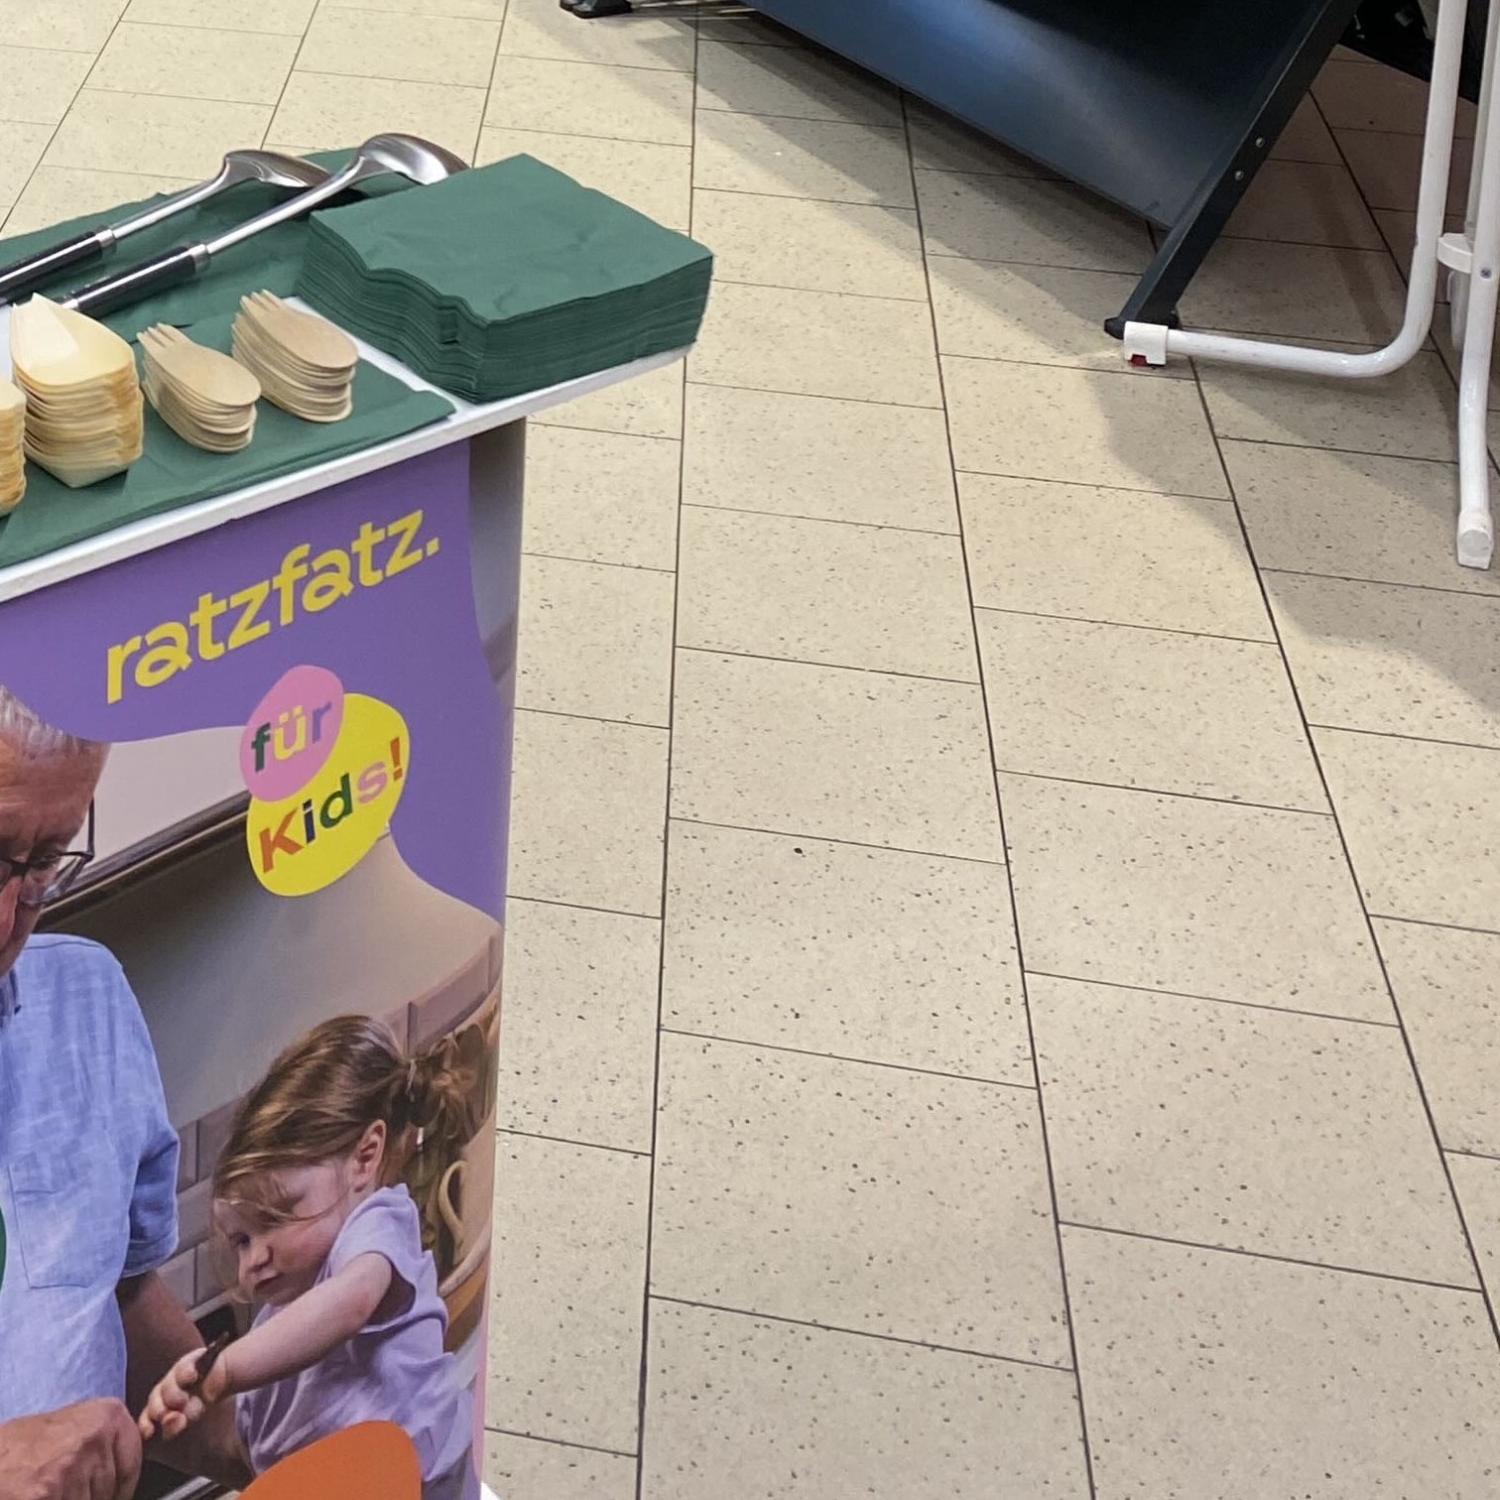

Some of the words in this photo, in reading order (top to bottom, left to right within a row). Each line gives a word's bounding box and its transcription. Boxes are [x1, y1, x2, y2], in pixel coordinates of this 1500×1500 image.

[107, 509, 440, 705] ratzfatz.
[251, 702, 332, 773] für
[259, 736, 404, 874] Kids!
